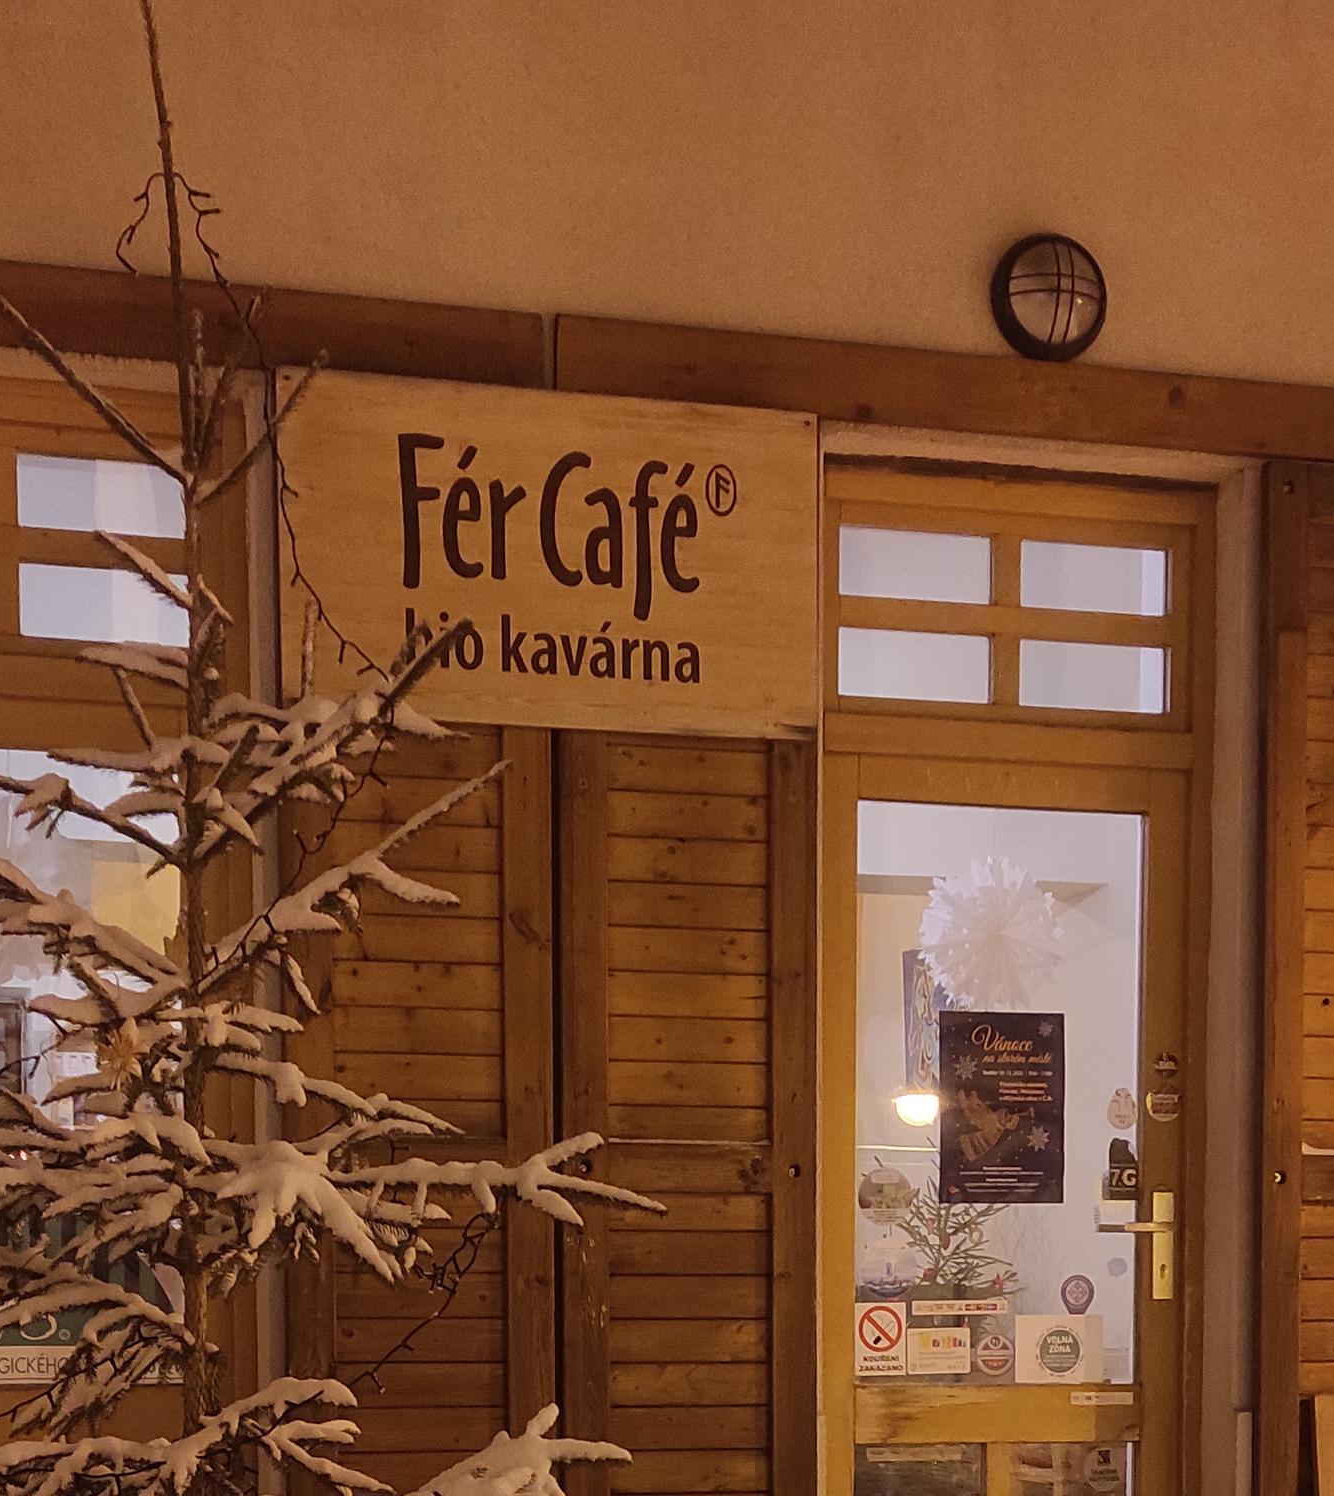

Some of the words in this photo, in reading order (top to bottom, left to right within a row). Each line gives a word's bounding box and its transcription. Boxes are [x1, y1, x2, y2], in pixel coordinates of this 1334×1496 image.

[397, 432, 527, 590] Fér
[539, 450, 701, 621] Café
[500, 613, 701, 685] kavárna
